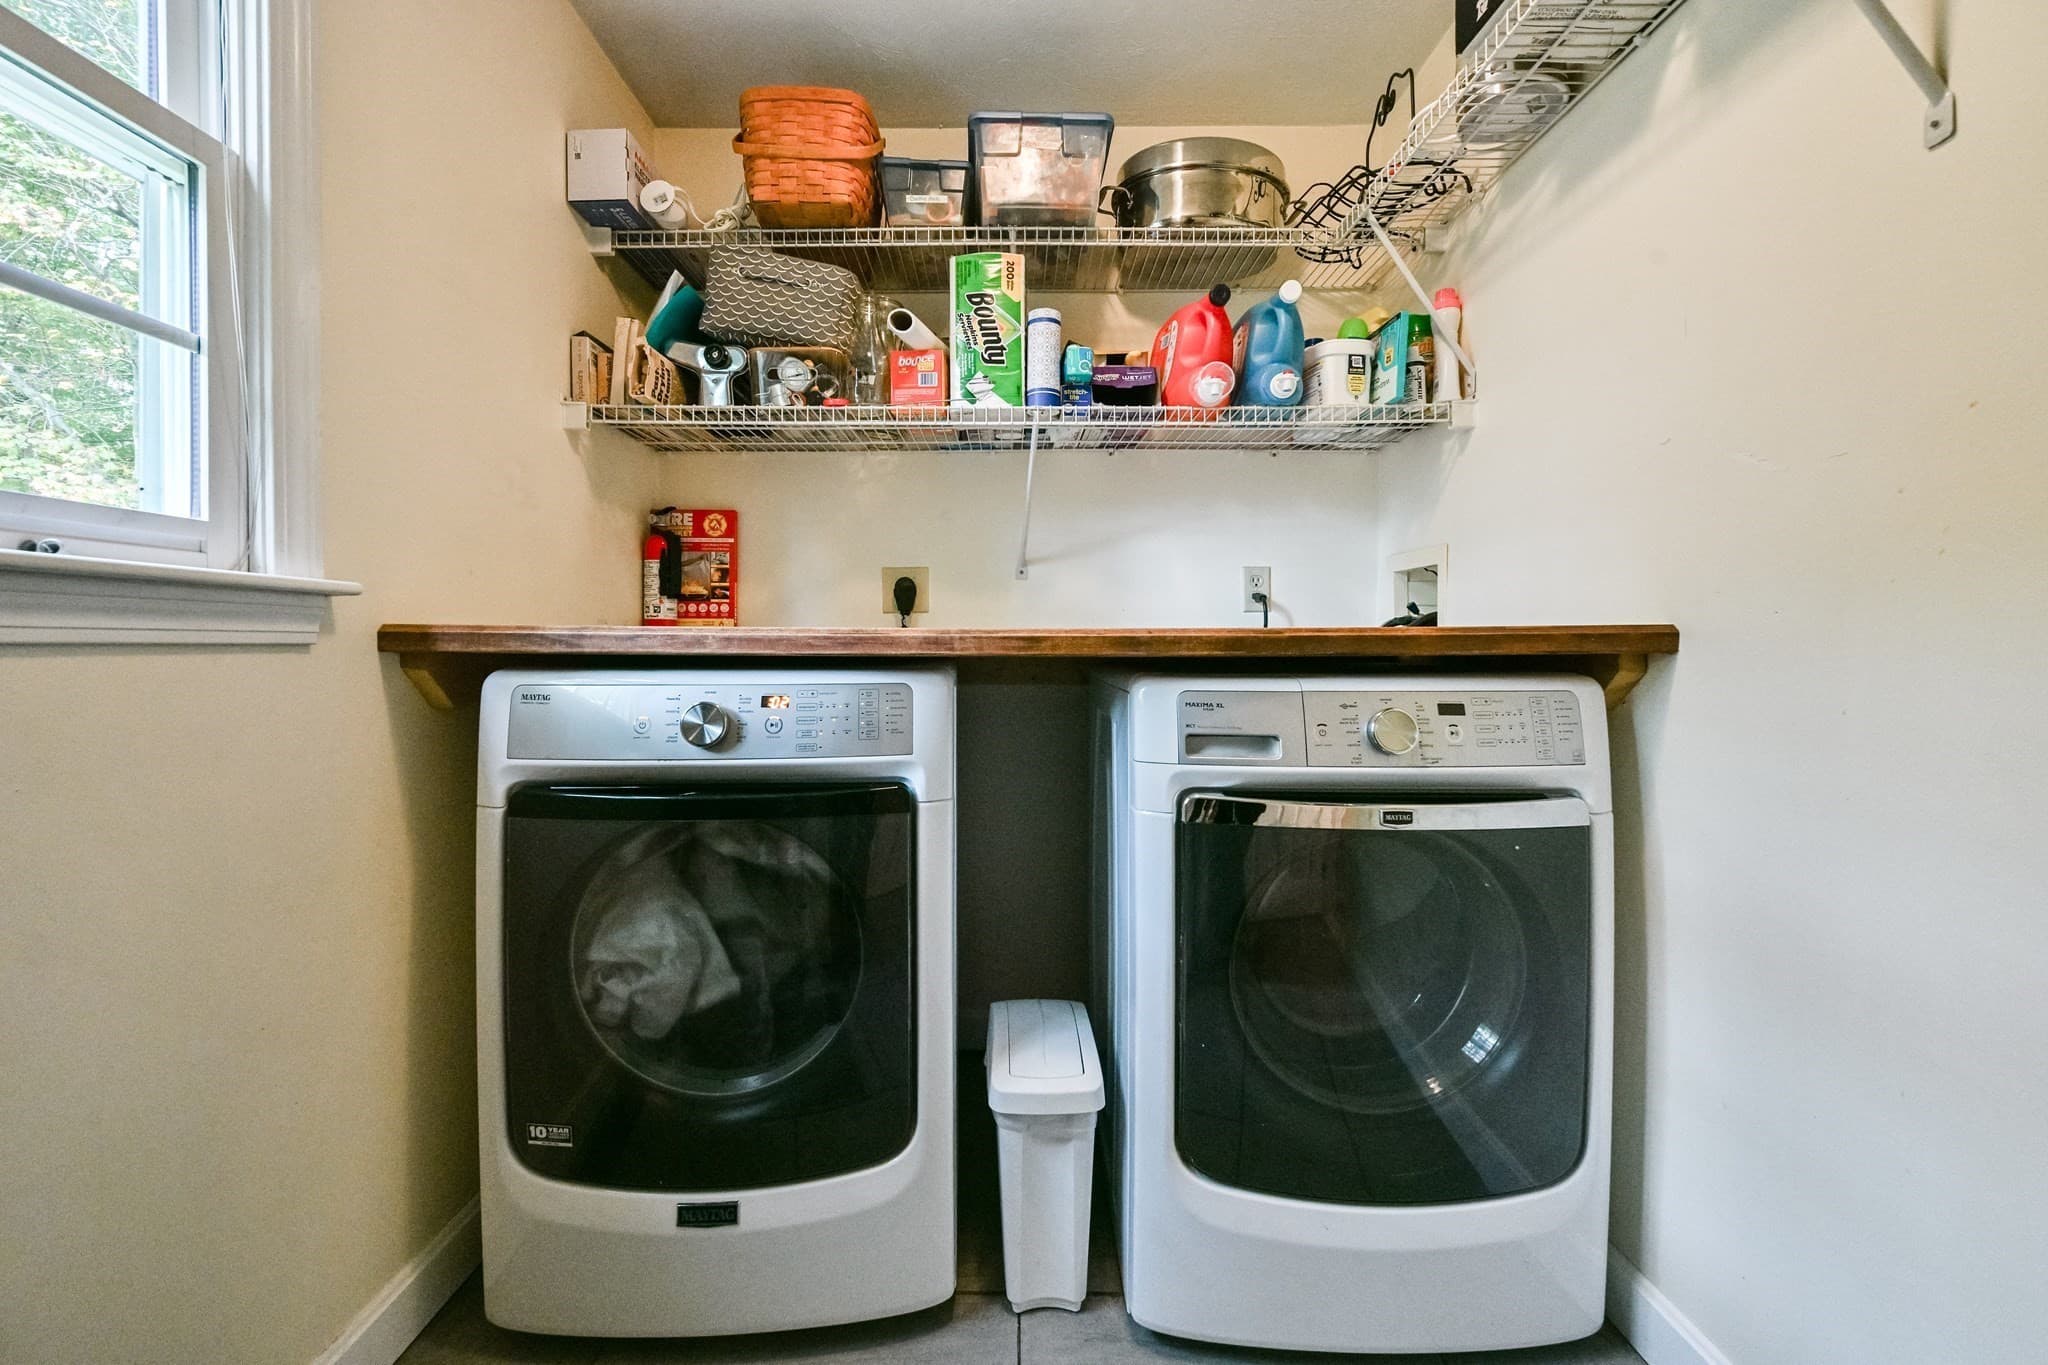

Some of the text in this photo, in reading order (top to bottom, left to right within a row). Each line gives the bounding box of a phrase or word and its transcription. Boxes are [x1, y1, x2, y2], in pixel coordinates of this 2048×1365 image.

[1006, 260, 1015, 280] 200
[957, 313, 973, 350] Serviettes
[965, 292, 1008, 365] Bounty
[965, 314, 978, 346] Napkins
[898, 354, 936, 367] bounce
[520, 693, 551, 701] MAYTAG
[529, 1125, 547, 1138] 10
